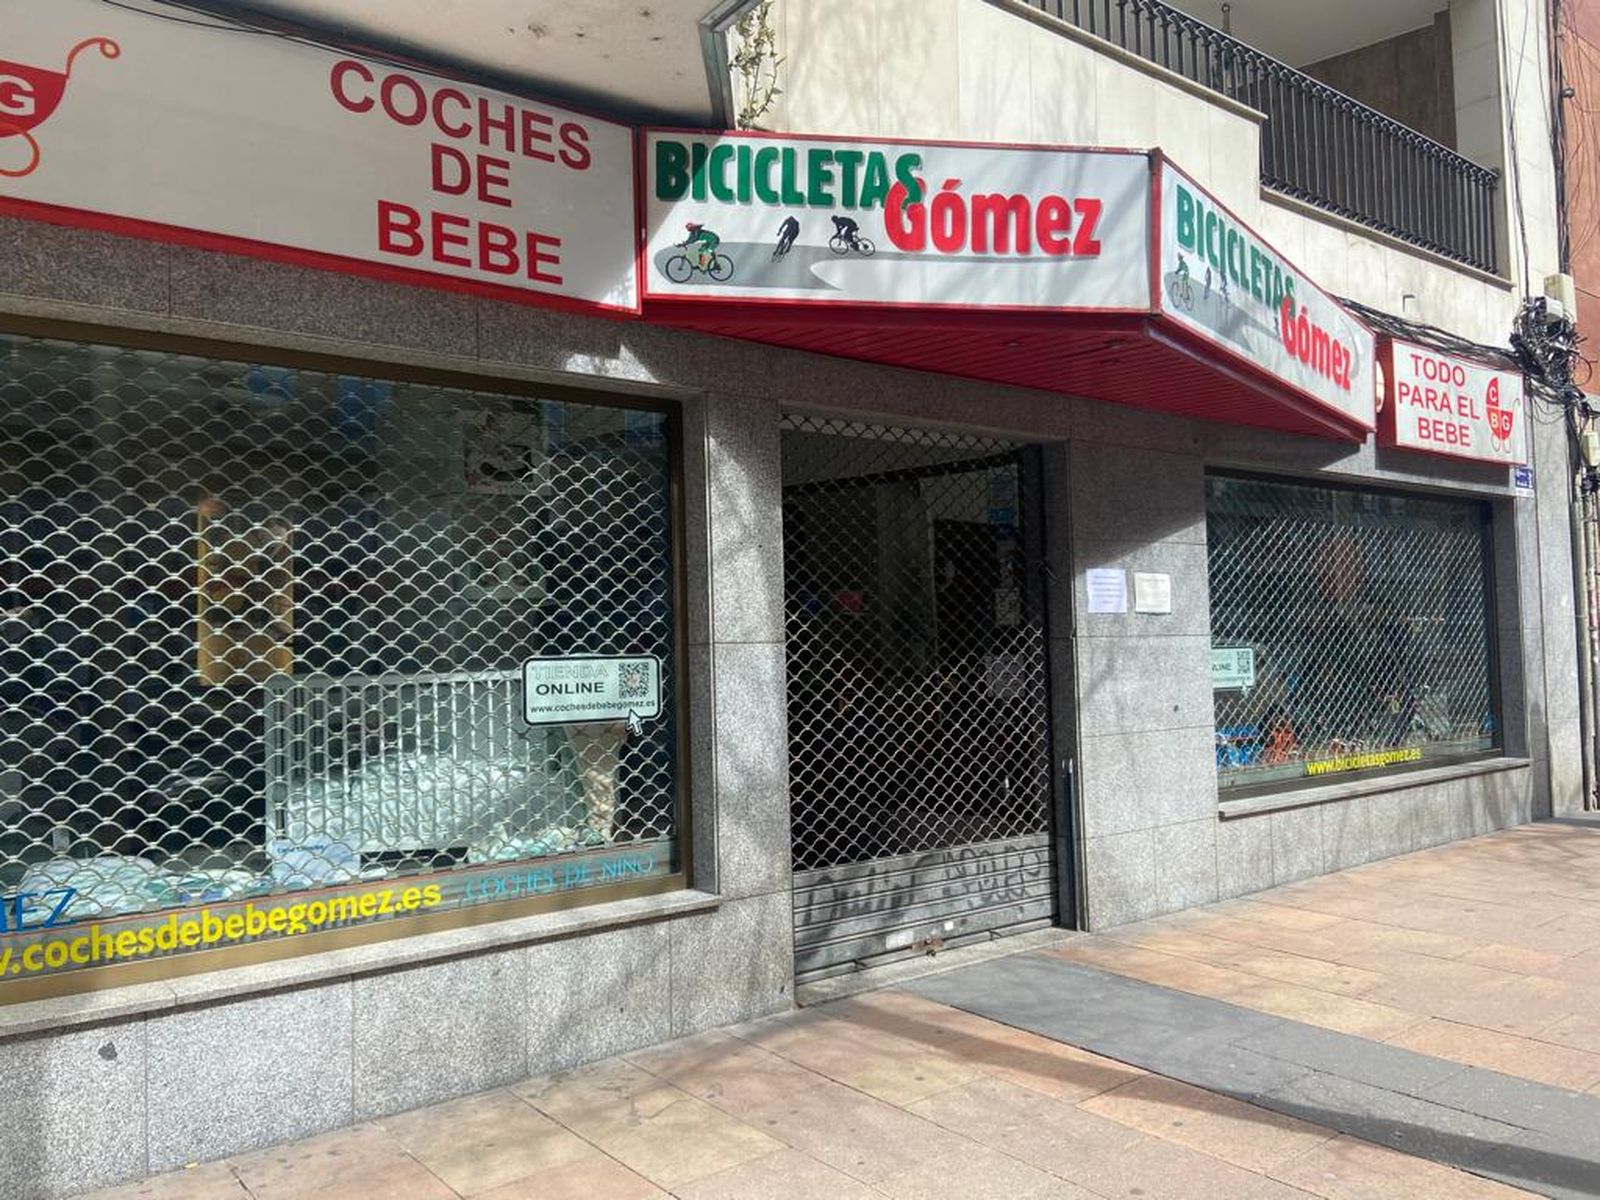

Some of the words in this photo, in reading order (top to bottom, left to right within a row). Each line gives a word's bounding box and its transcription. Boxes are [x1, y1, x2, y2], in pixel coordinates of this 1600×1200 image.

[330, 60, 592, 170] COCHES
[430, 142, 512, 208] DE
[655, 140, 925, 208] BICICLETAS
[377, 199, 564, 285] BEBE
[883, 178, 1101, 257] Gómez
[1176, 183, 1296, 320] BICICLETAS
[1279, 294, 1351, 391] Gómez
[1410, 353, 1465, 387] TODO
[1398, 380, 1453, 415] PARA
[1457, 395, 1480, 420] EL
[1418, 417, 1471, 447] BEBE
[531, 663, 609, 681] TIENDA
[536, 682, 605, 696] ONLINE
[530, 700, 656, 713] www.cochesdebebegomez.es
